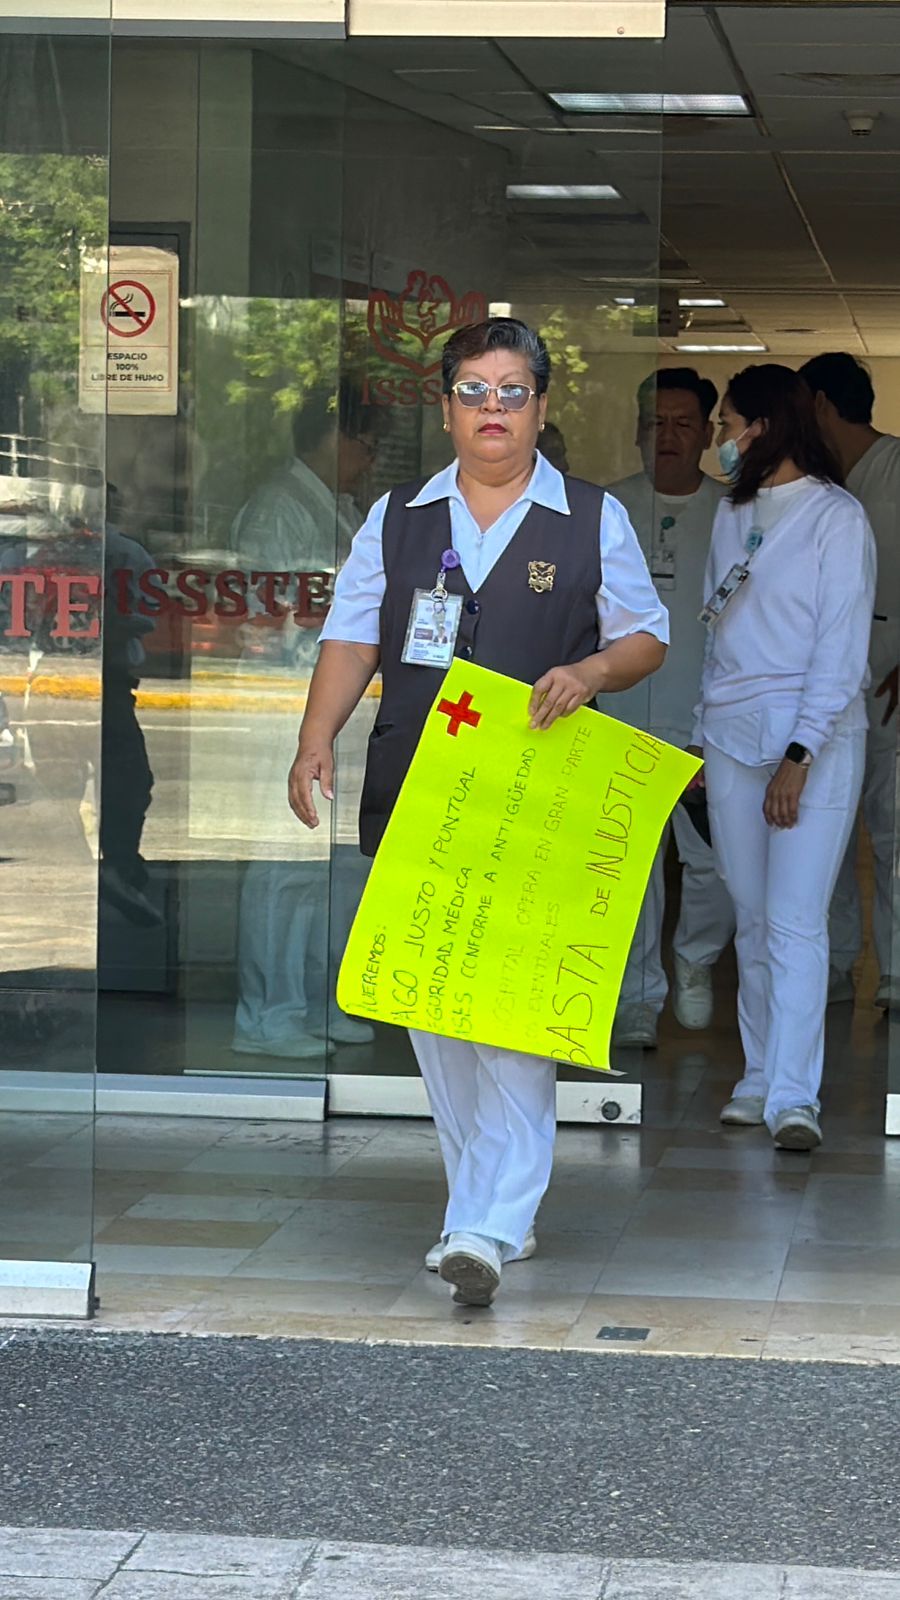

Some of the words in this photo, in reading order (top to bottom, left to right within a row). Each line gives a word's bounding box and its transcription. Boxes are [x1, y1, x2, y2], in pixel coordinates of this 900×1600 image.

[91, 373, 117, 382] LIBRE
[119, 373, 132, 381] DE
[134, 373, 164, 382] HUMO
[106, 353, 148, 361] ESPACIO
[115, 363, 139, 371] 100%
[112, 567, 332, 619] ISSSTE
[432, 767, 477, 854] PUNTUAL
[490, 748, 537, 861] ANTIGÜEDAD
[517, 869, 542, 926] OPERA
[535, 837, 553, 863] EN
[544, 786, 569, 833] GRAN
[562, 726, 592, 775] PARTE
[585, 732, 666, 881] INJUSTICIA
[428, 857, 445, 870] Y
[484, 871, 497, 883] A
[404, 881, 436, 958] JUSTO
[442, 866, 472, 935] MÉDICA
[590, 887, 612, 917] DE
[460, 895, 492, 979] CONFORME
[391, 969, 419, 1024] AGO
